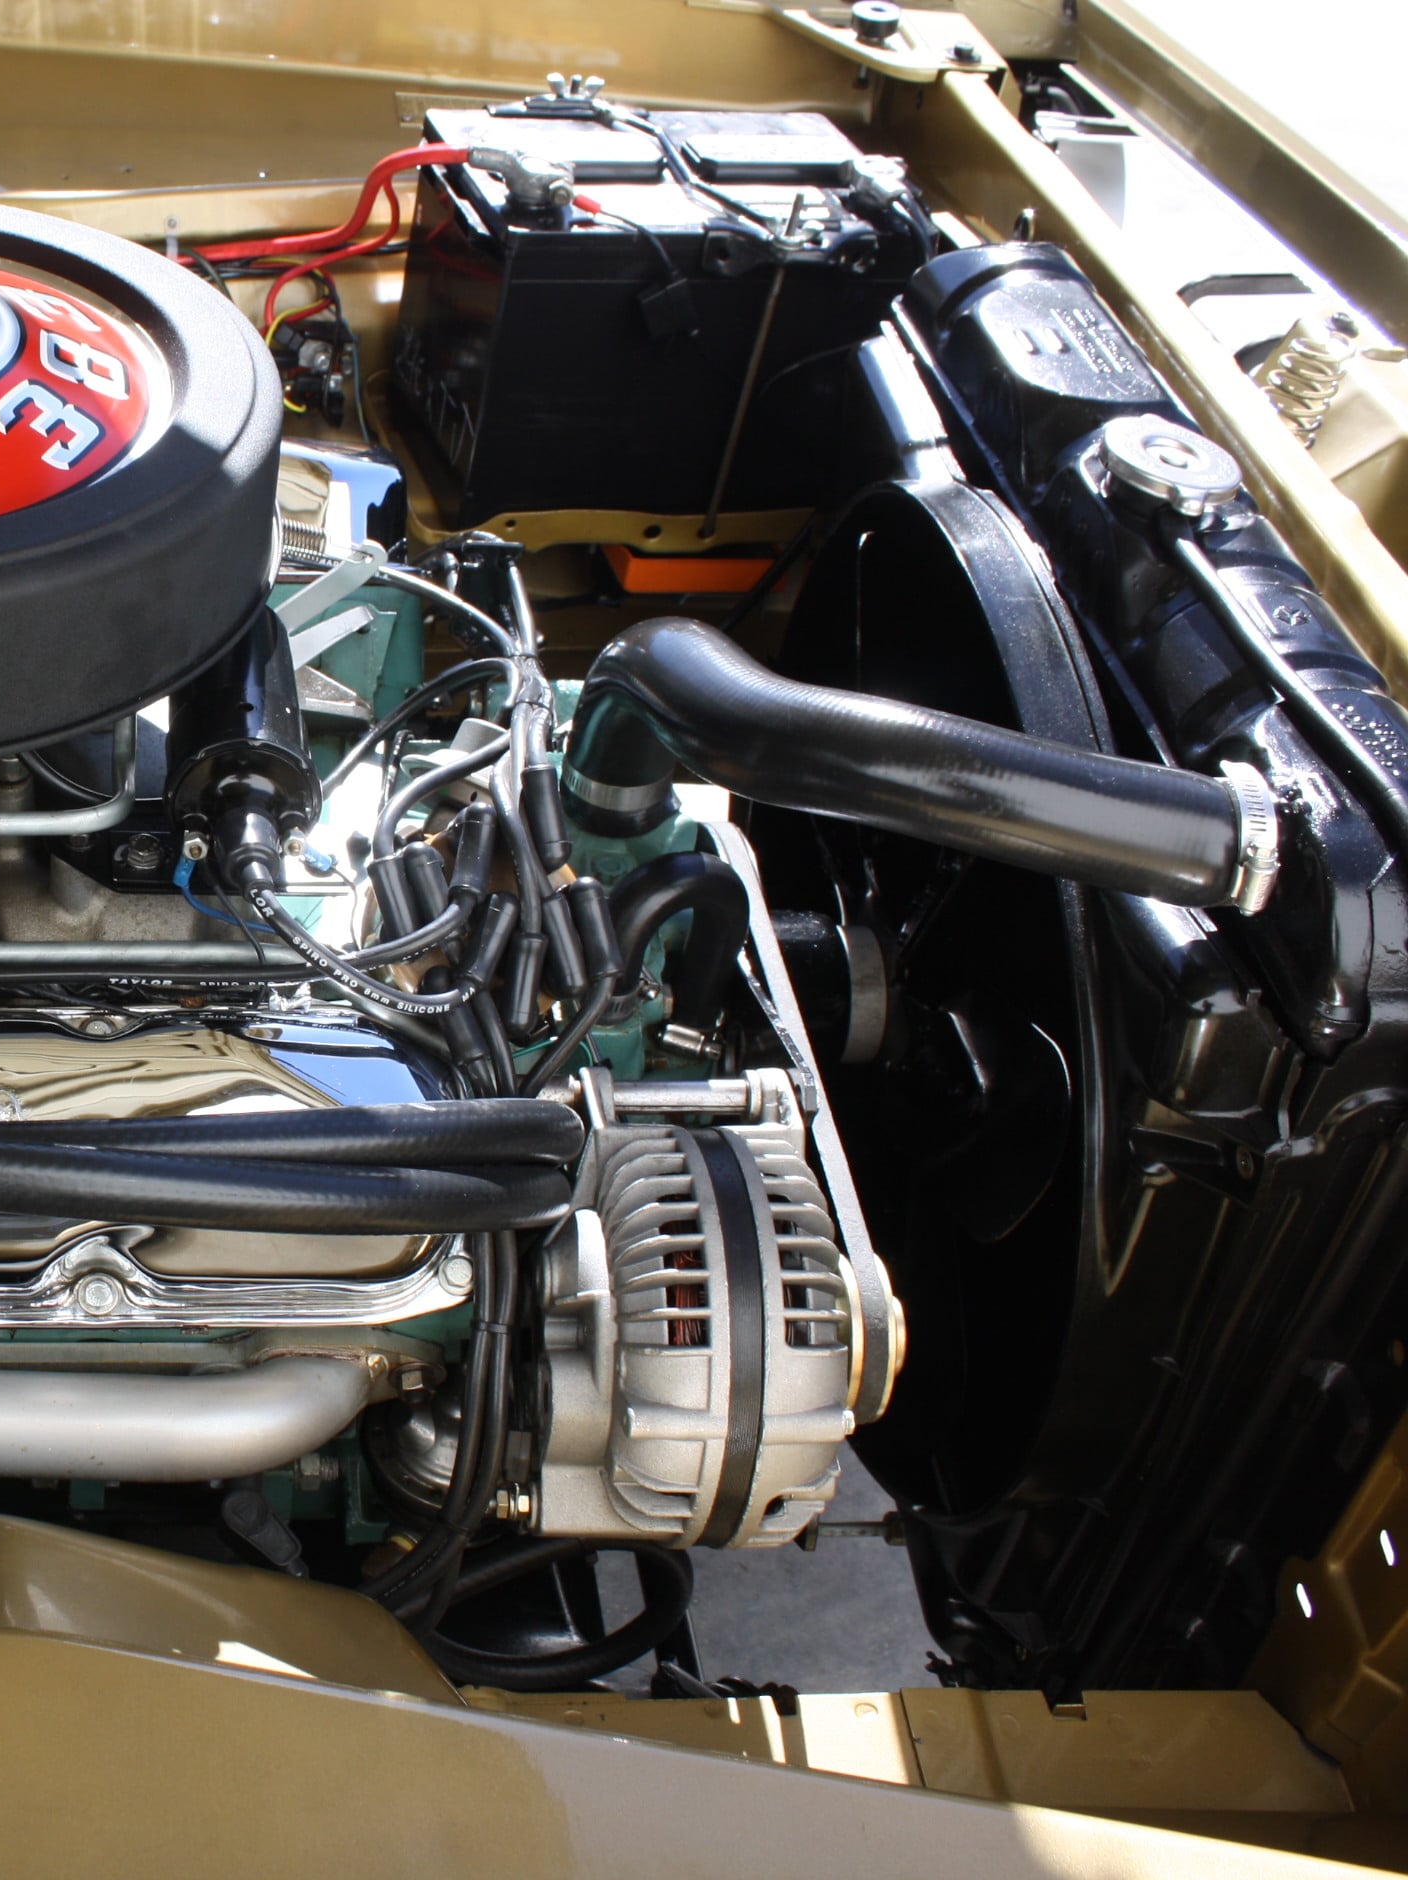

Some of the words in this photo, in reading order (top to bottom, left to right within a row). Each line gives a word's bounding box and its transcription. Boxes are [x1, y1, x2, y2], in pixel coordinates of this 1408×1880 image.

[109, 978, 173, 986] TAYLOR
[293, 936, 328, 968] SPIRO
[333, 968, 358, 989] PRO
[363, 987, 390, 1006] 8mm
[396, 1001, 451, 1014] SILICONE
